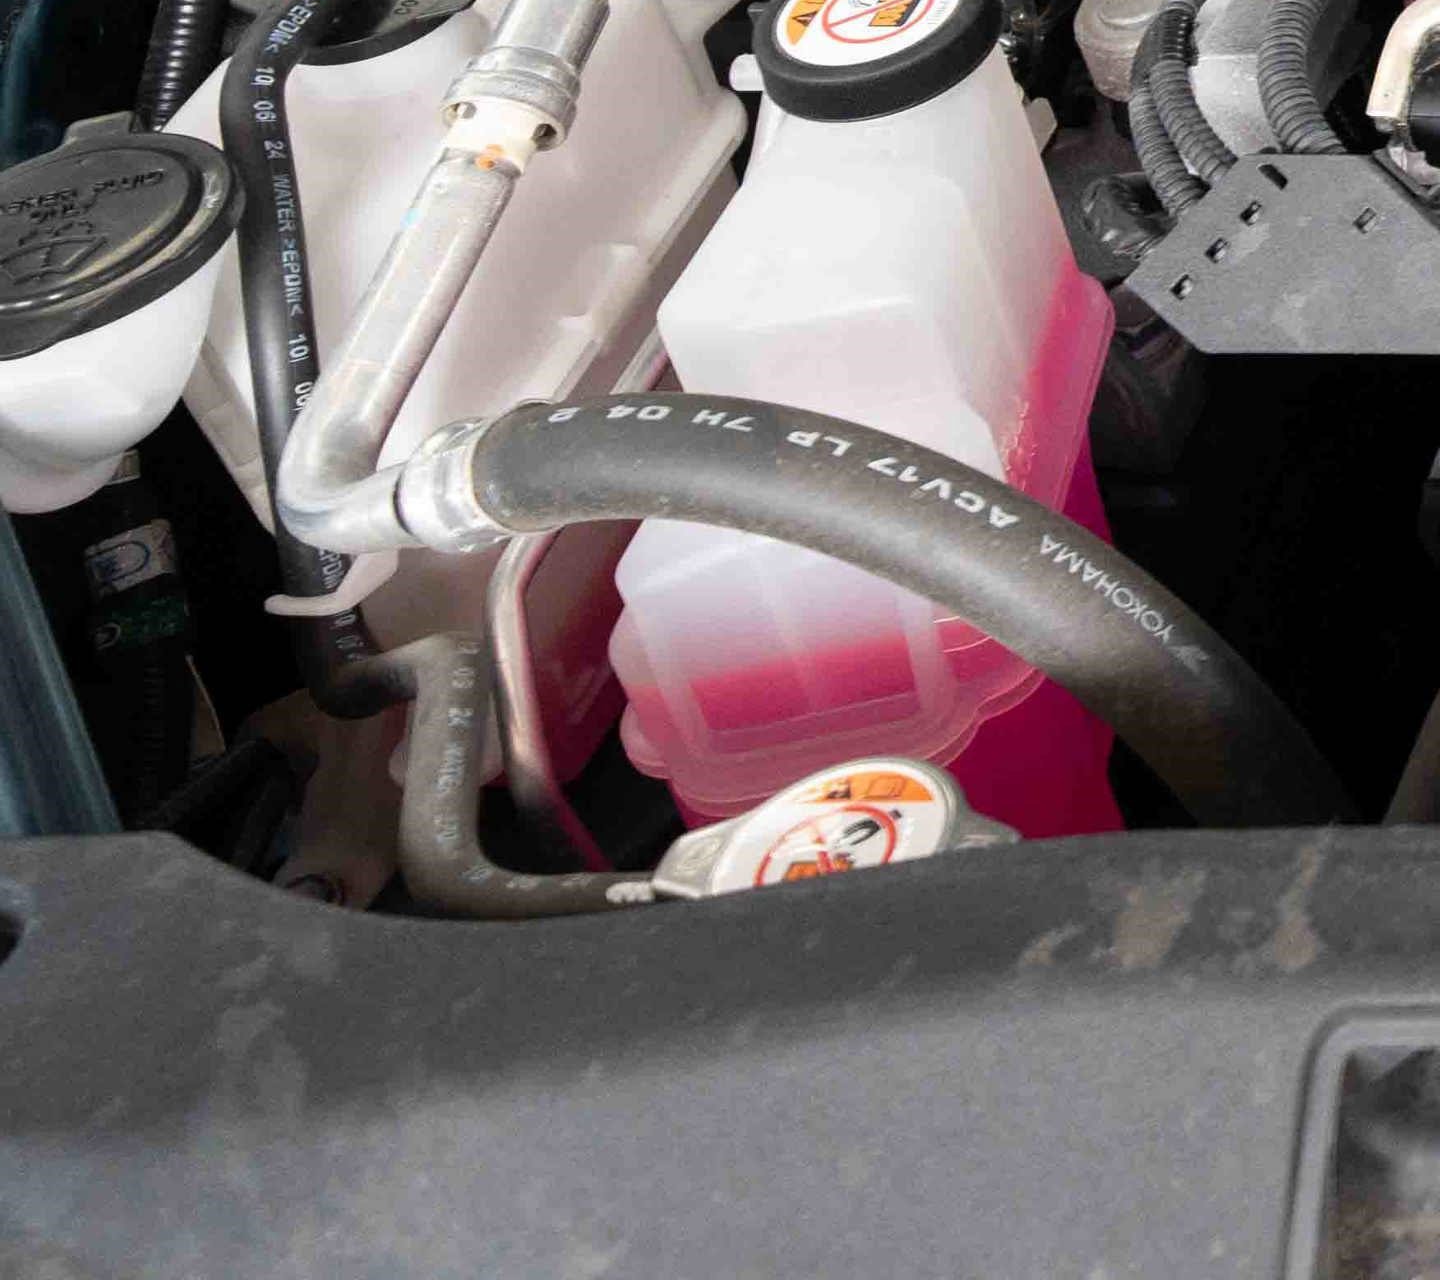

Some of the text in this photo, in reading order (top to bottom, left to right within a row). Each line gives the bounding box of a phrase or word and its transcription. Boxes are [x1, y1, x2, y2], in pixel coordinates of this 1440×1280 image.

[271, 173, 291, 234] WATER
[606, 404, 674, 422] 04
[785, 429, 855, 458] LP
[866, 456, 1021, 529] ACV17
[1039, 534, 1178, 643] YOKOHAMA
